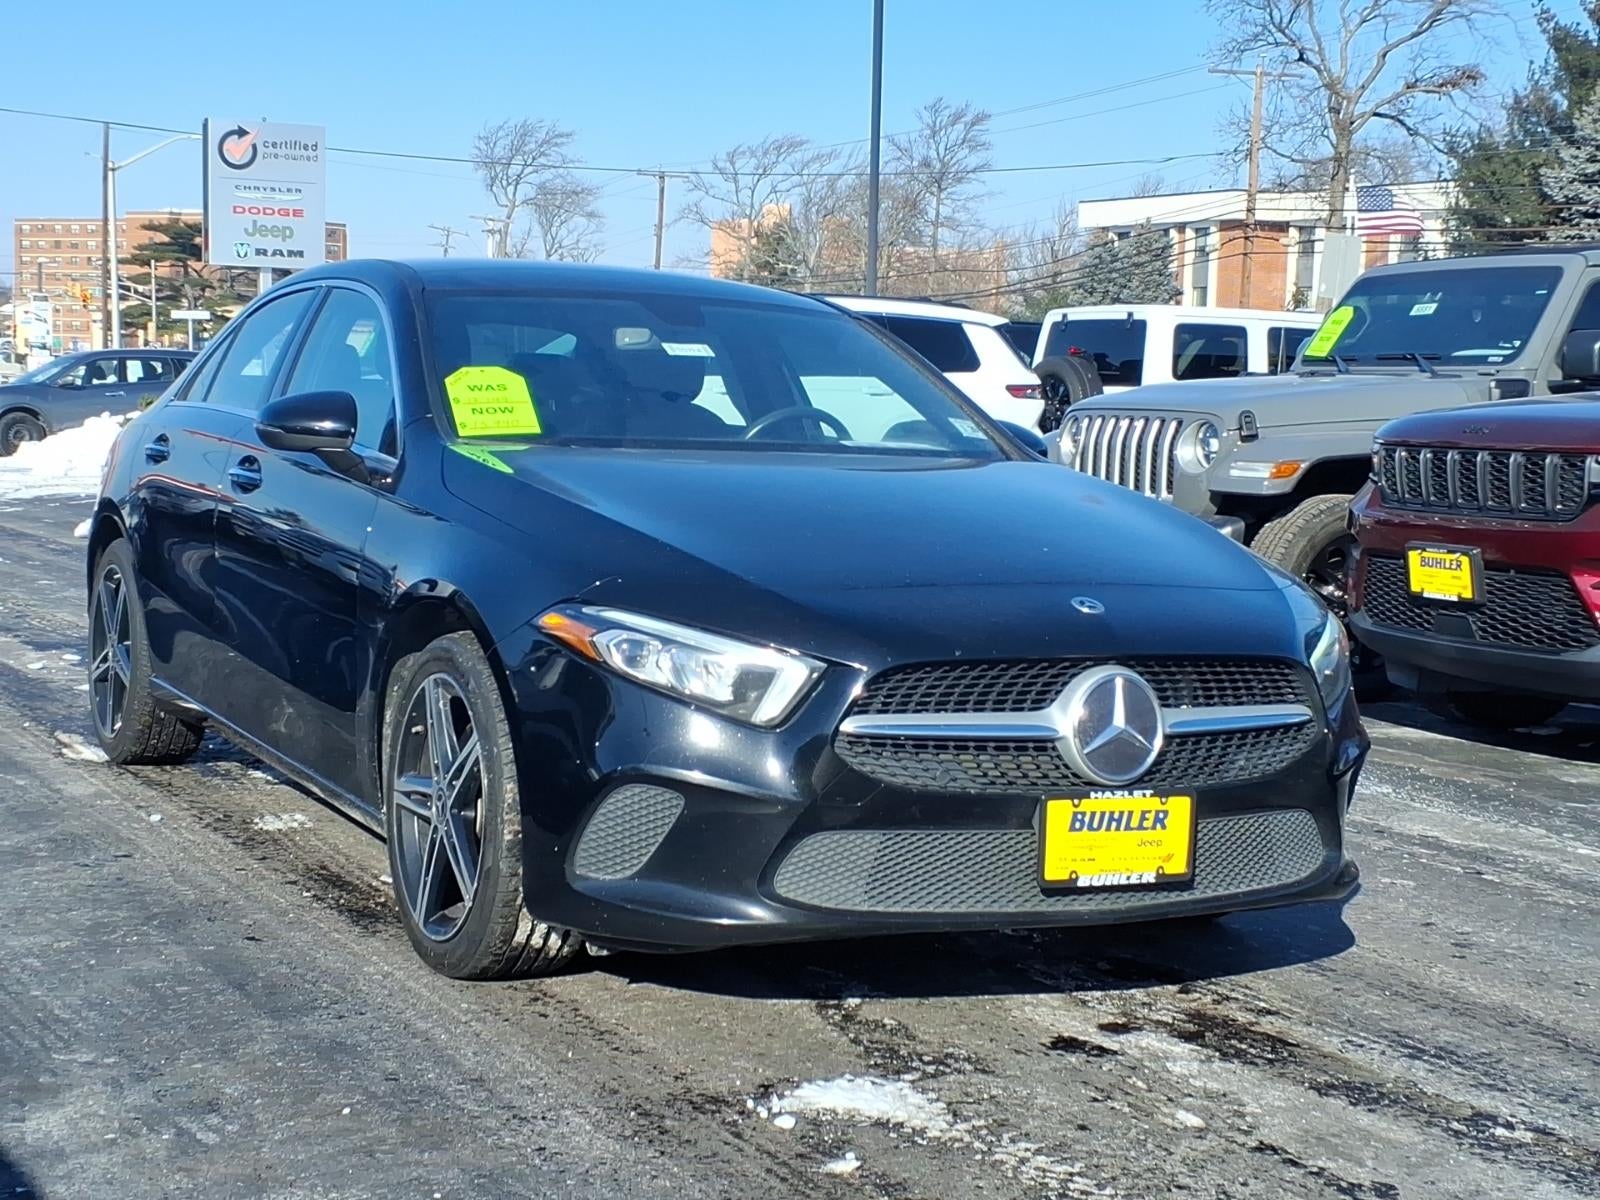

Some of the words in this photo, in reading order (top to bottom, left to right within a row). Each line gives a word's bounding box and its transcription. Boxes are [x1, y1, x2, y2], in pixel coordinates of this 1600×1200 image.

[262, 139, 318, 152] certified
[262, 151, 318, 163] pre-owned
[234, 184, 303, 194] CHRYSLER
[232, 205, 305, 218] DODGE
[243, 219, 294, 242] Jeep
[254, 247, 305, 259] RAM
[467, 383, 508, 392] WAS
[471, 406, 515, 415] NOW
[1420, 556, 1463, 572] BUHLER
[1068, 809, 1170, 833] BUHLER
[1137, 838, 1163, 848] Jeep
[1077, 871, 1156, 887] BUHLER
